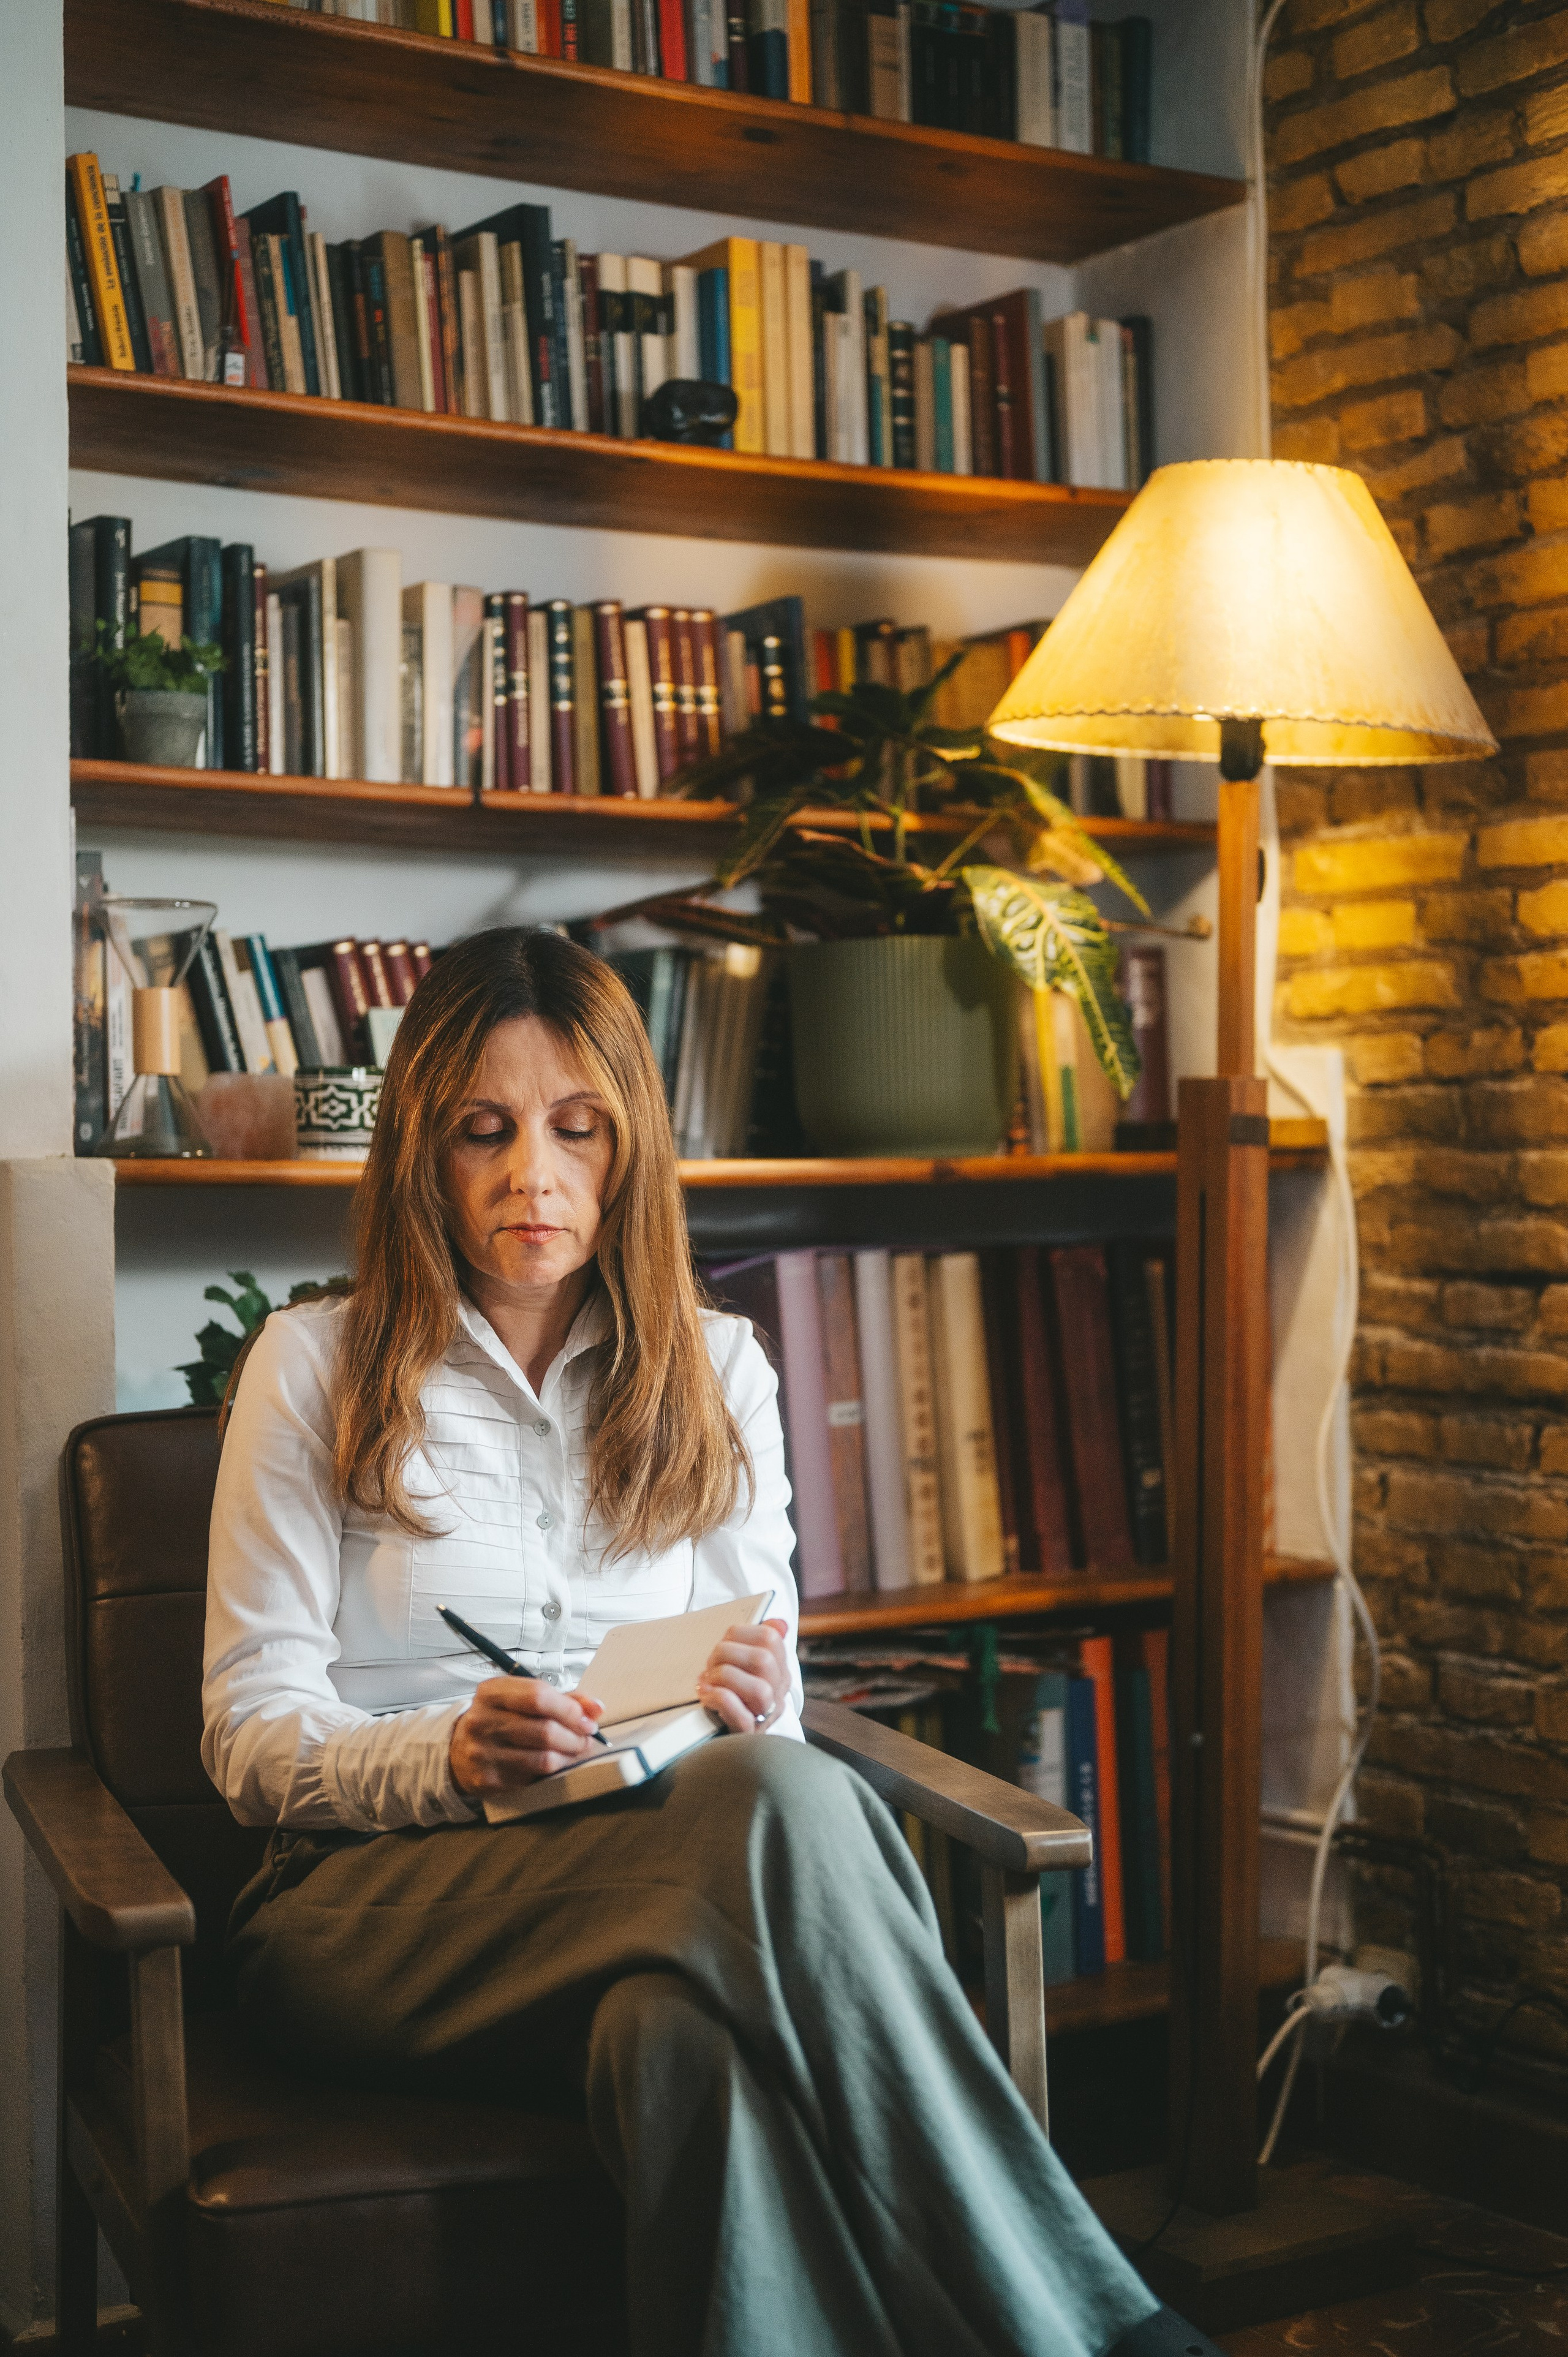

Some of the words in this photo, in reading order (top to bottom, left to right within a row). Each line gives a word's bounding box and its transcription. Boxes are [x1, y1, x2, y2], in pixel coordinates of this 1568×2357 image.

[94, 211, 103, 220] la
[97, 222, 105, 233] de
[107, 279, 115, 289] La
